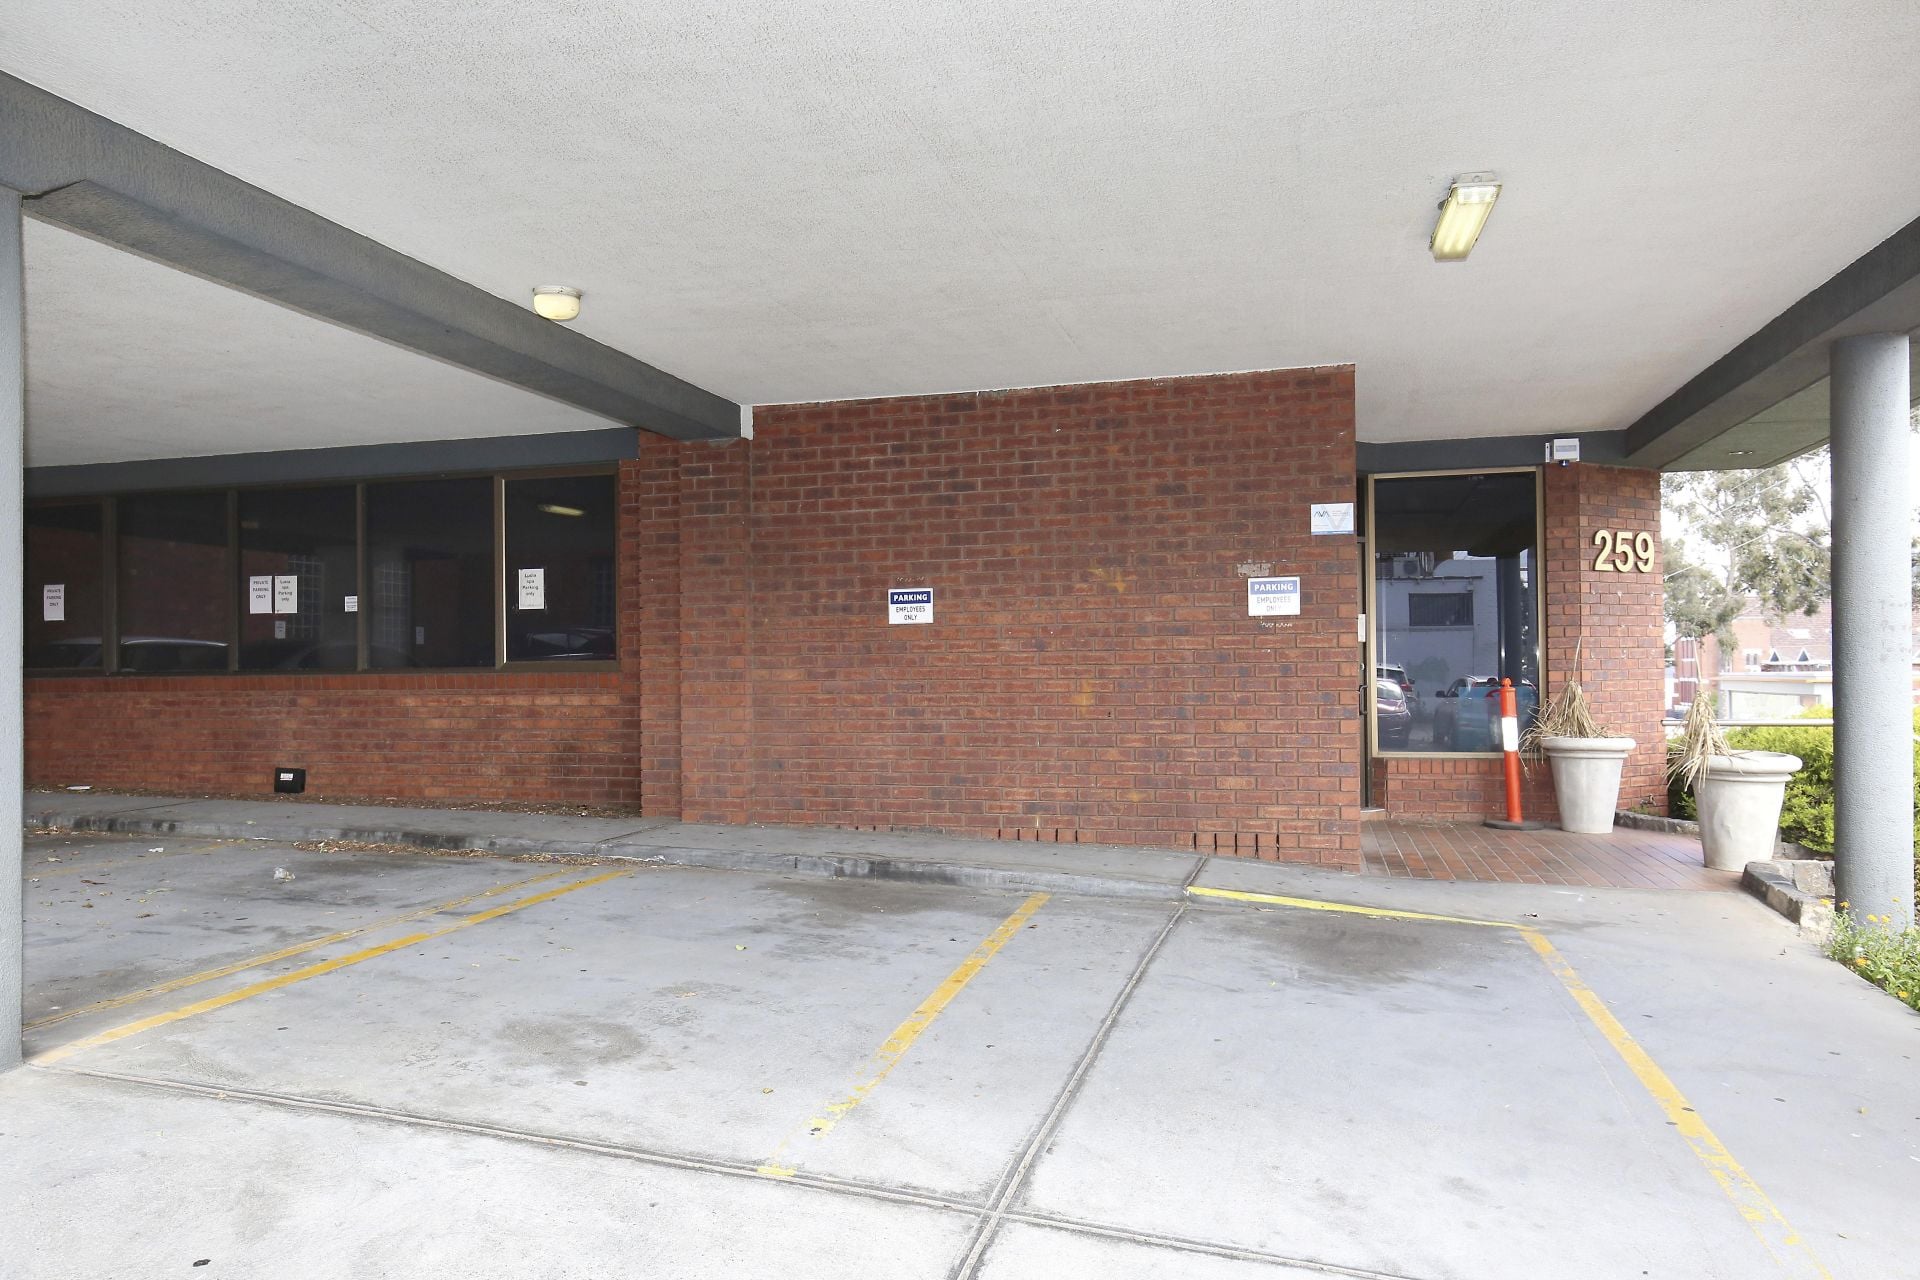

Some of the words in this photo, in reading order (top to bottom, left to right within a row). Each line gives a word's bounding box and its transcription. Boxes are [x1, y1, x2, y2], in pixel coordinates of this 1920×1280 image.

[1594, 529, 1655, 573] 259
[1254, 583, 1294, 592] PARKING
[893, 593, 928, 602] PARKING
[1256, 596, 1292, 604] EMPLOYEES
[895, 605, 926, 613] EMPLOYEES
